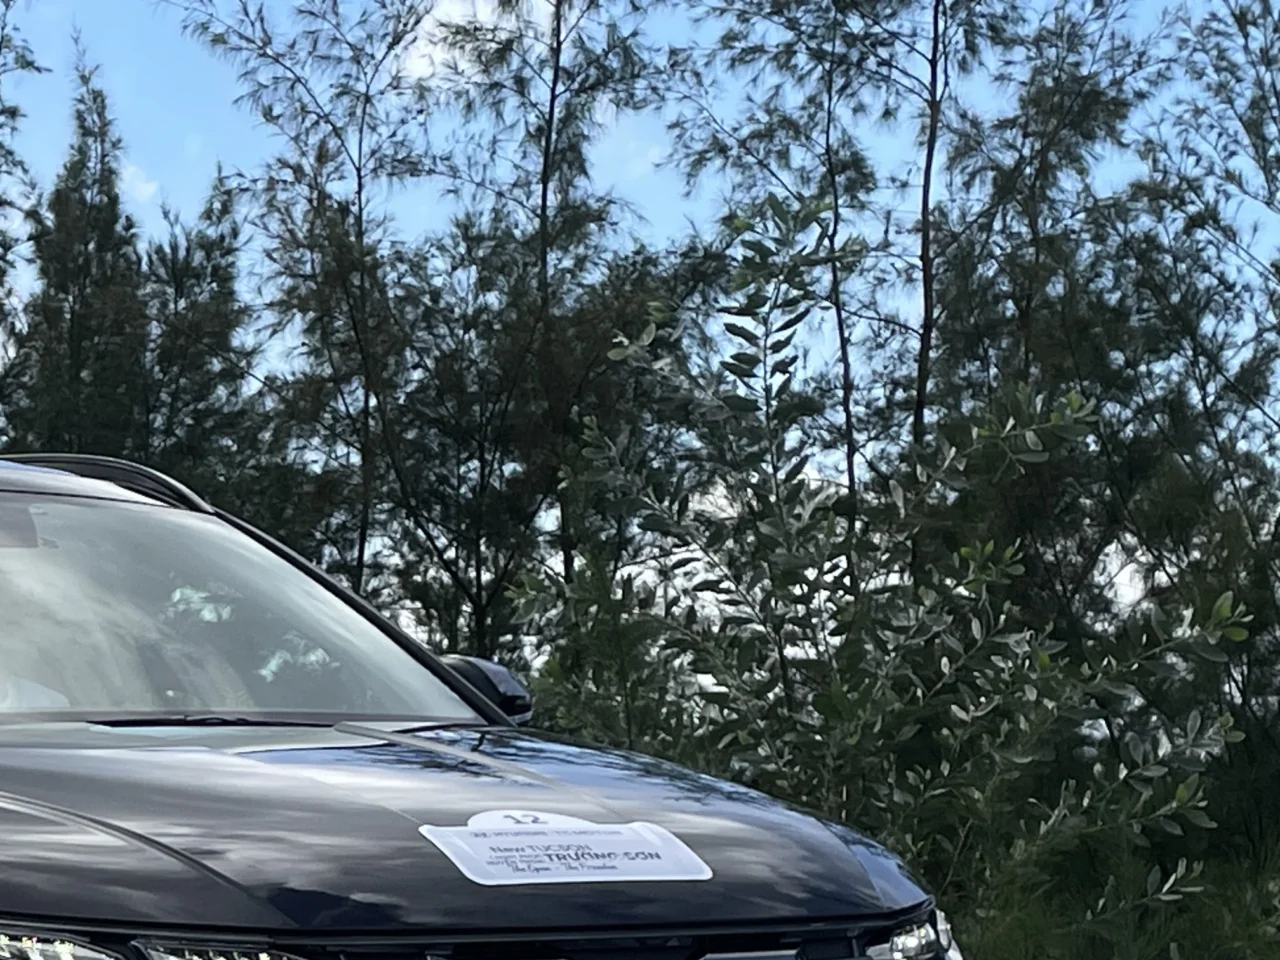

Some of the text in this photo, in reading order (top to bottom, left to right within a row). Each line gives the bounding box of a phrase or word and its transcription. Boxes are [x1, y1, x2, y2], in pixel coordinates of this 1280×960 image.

[503, 814, 549, 825] 12
[489, 844, 593, 854] New TUCSON
